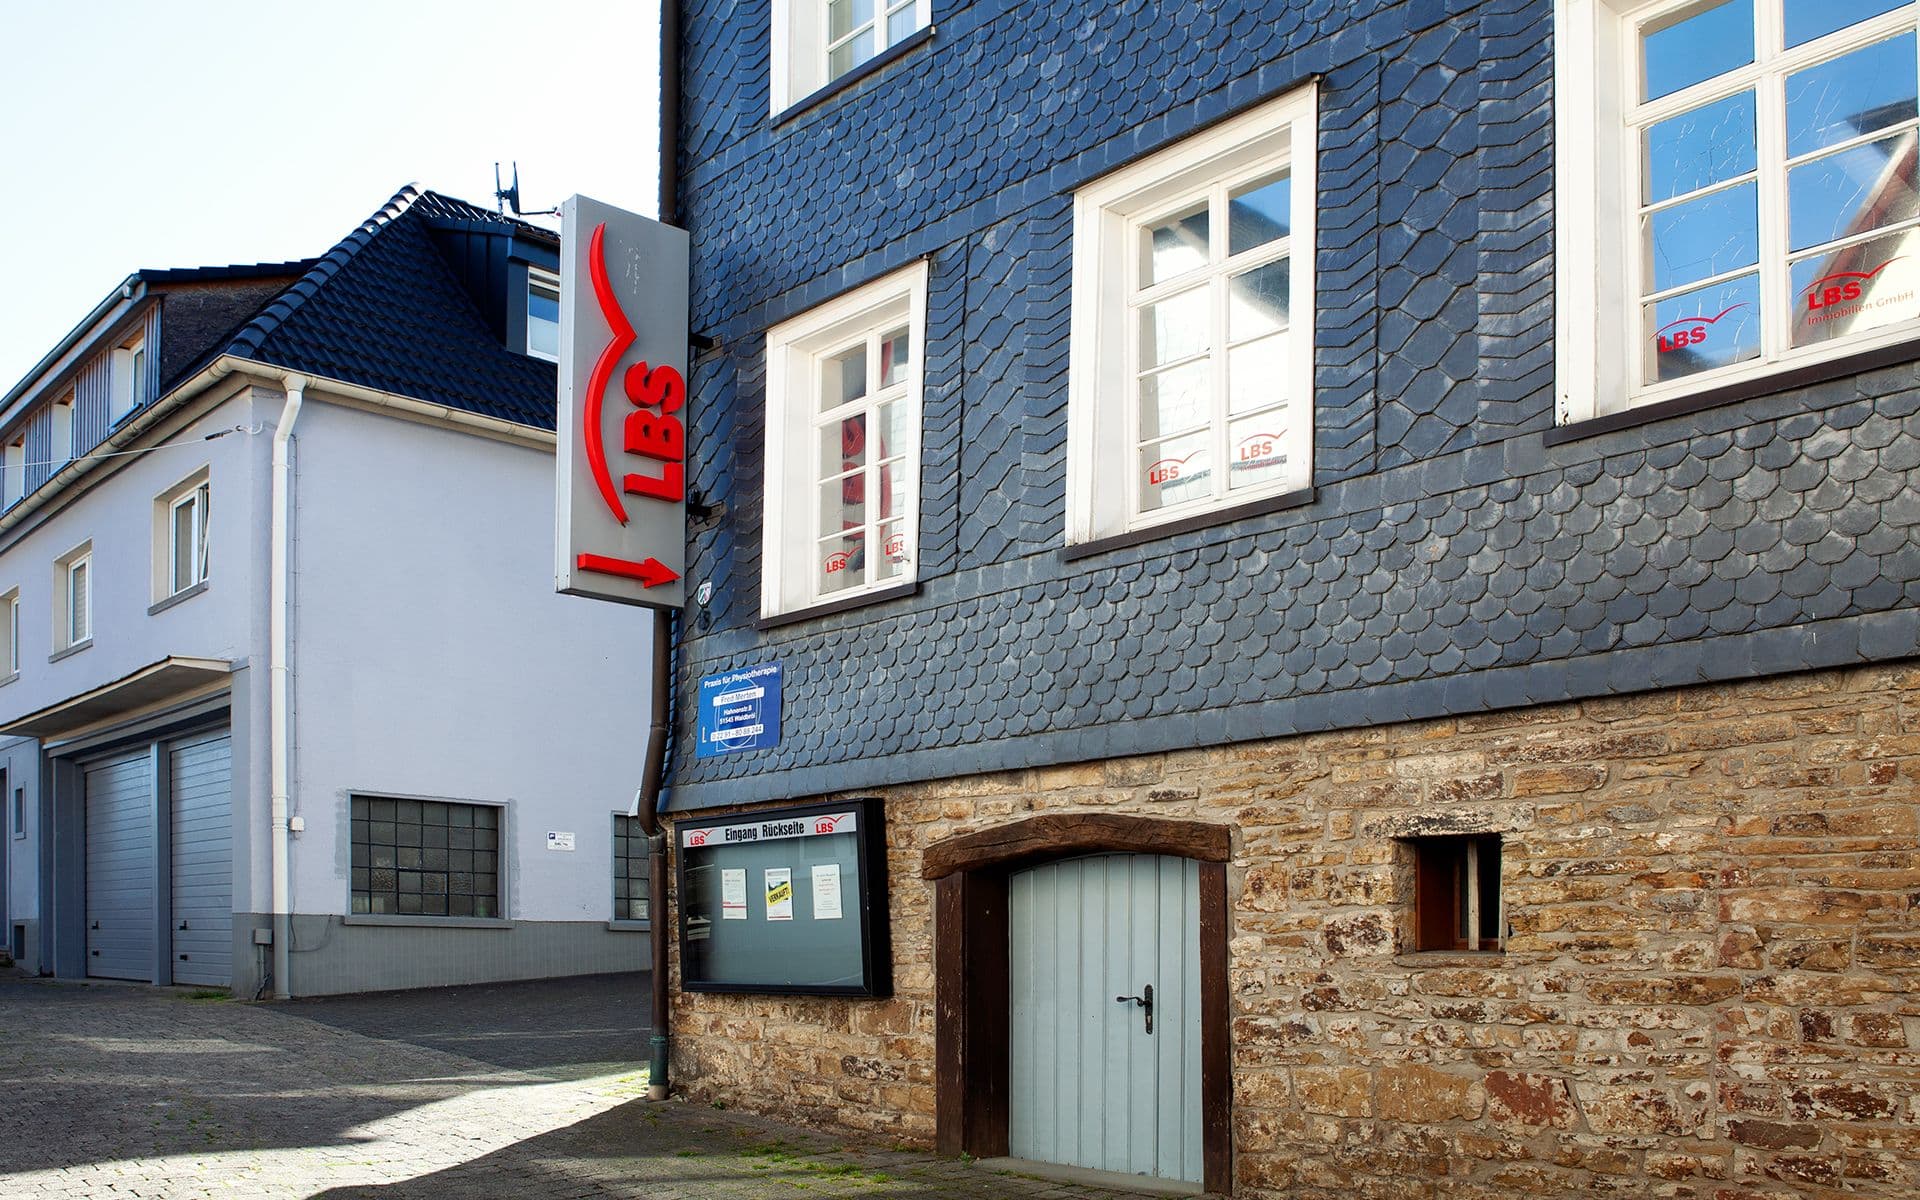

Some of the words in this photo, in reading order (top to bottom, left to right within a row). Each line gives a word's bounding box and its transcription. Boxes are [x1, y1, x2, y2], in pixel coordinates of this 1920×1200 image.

[1808, 281, 1862, 311] LBS
[1808, 302, 1873, 326] Immobilien
[1876, 290, 1914, 308] GmbH
[1659, 325, 1707, 353] LBS
[624, 360, 685, 503] LBS
[1240, 441, 1273, 461] LBS
[1150, 465, 1180, 485] LBS
[826, 558, 846, 573] LBS
[704, 679, 721, 689] Praxis
[722, 676, 731, 684] für
[731, 666, 777, 682] Physiotherapie
[725, 827, 758, 842] Eingang
[762, 821, 805, 837] Rückseite
[815, 822, 834, 834] LBS
[690, 835, 705, 846] LBS
